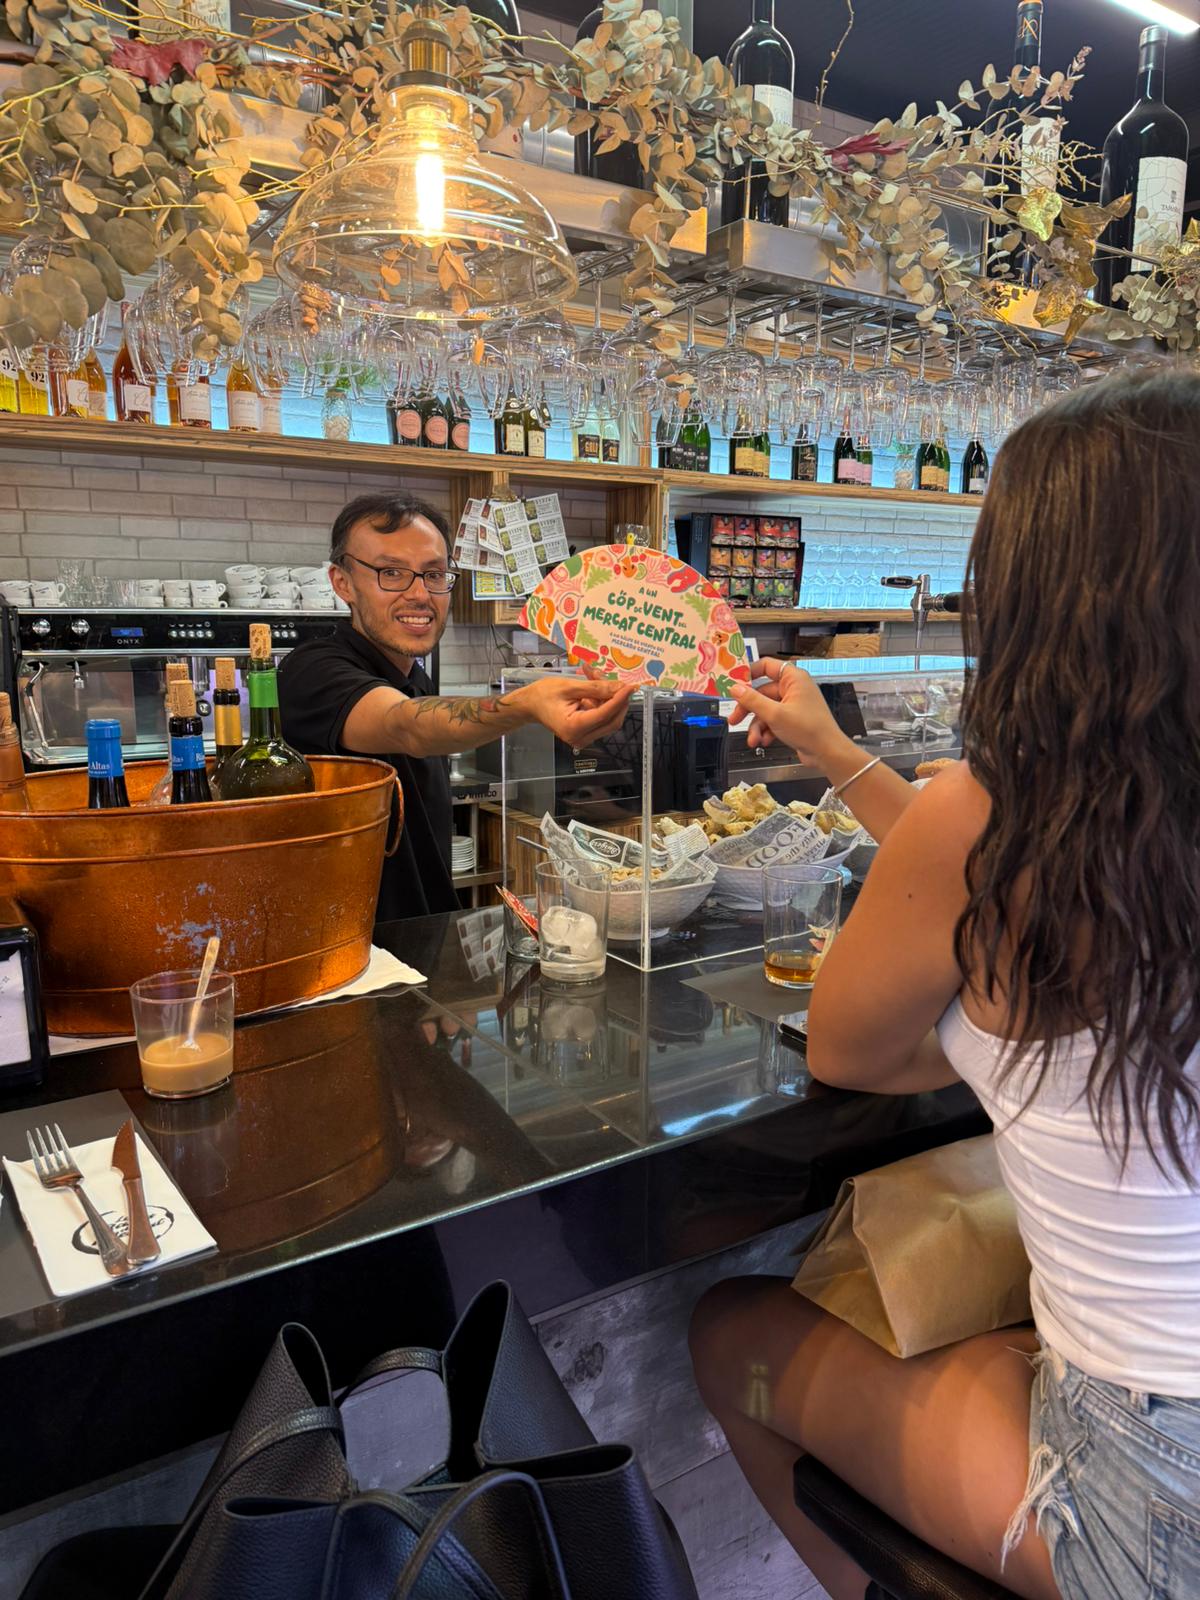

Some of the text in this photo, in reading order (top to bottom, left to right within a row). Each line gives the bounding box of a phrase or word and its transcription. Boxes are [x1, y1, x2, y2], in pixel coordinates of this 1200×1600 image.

[30, 371, 45, 383] 92
[639, 587, 658, 598] A UN
[643, 601, 684, 627] VENT
[583, 605, 696, 649] MERCAT CENTRAL
[91, 761, 111, 770] Altas
